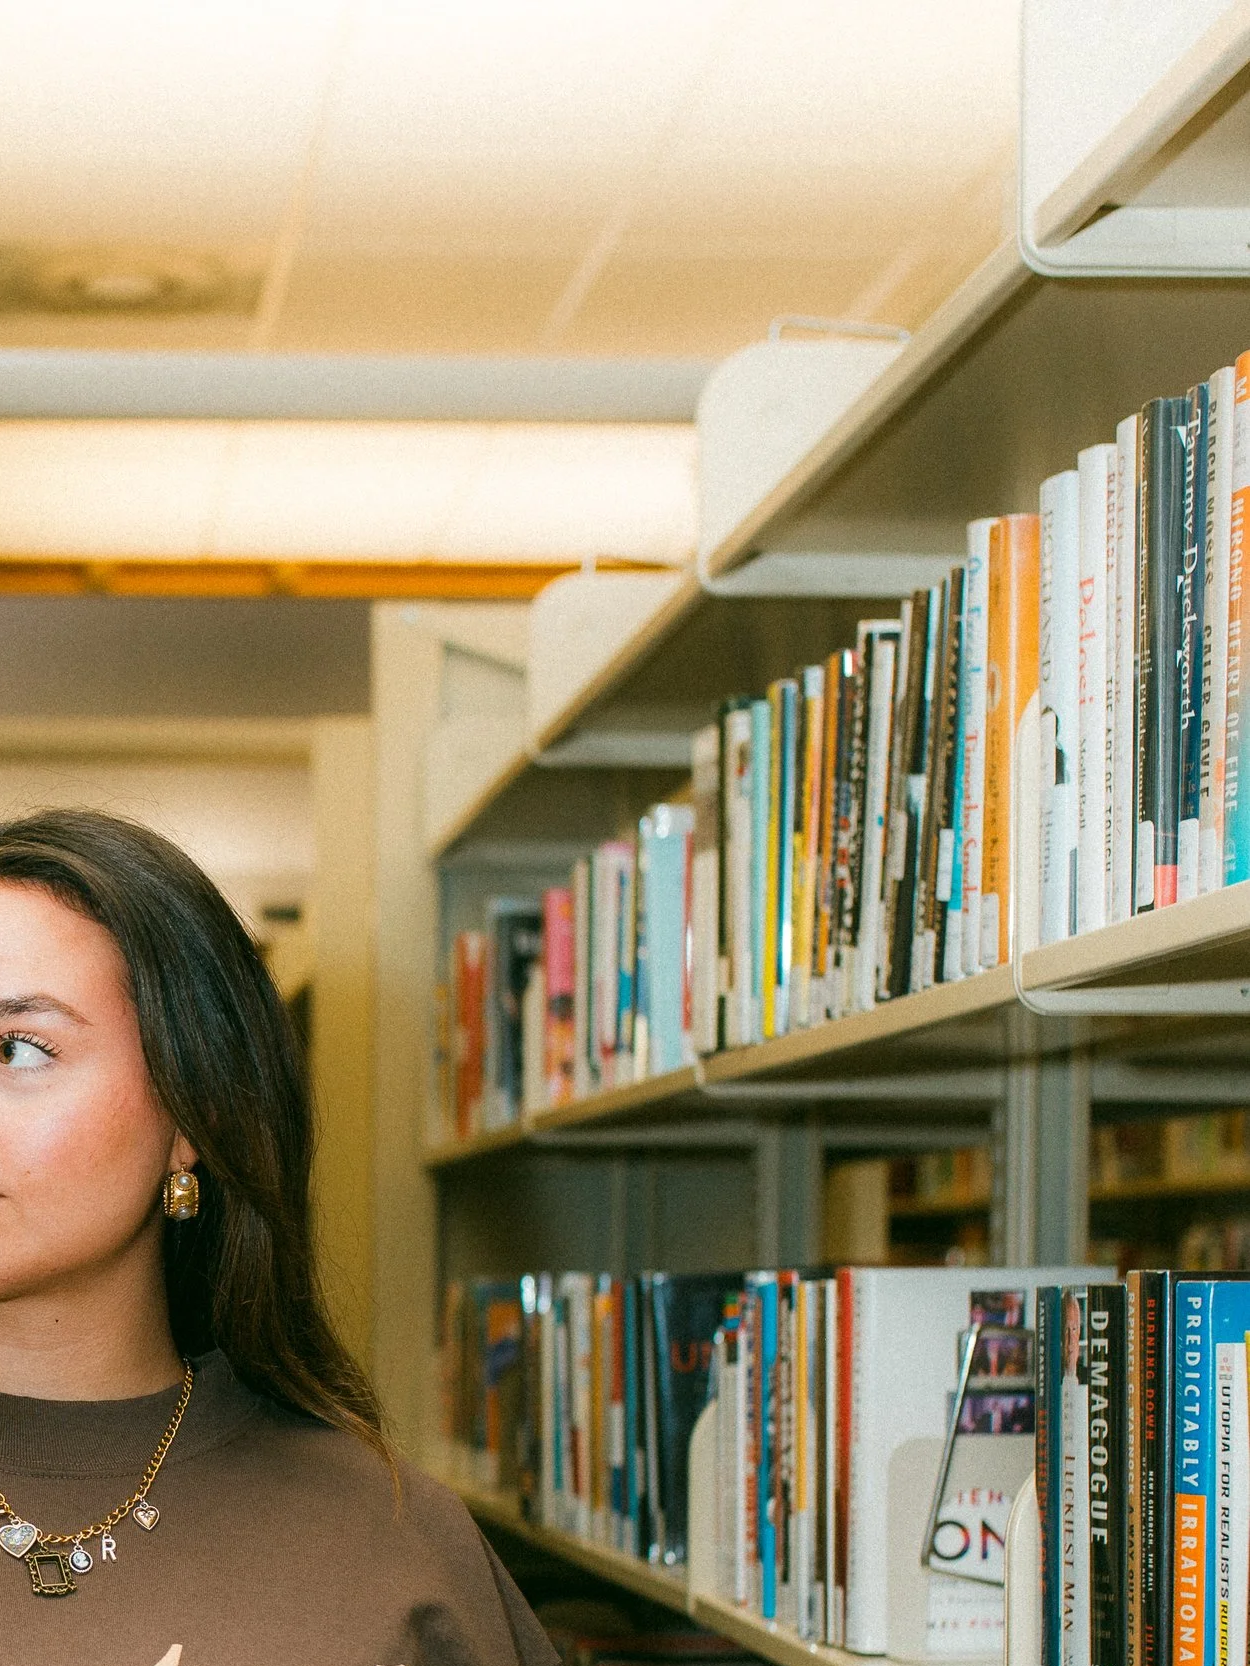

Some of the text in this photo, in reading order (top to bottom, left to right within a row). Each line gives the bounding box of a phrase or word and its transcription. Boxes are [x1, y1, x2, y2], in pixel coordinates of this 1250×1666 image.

[1204, 401, 1217, 588] BLACK MOSES
[1181, 408, 1202, 730] Tammy Duckworth
[1230, 497, 1246, 602] HIRONO
[1200, 625, 1213, 798] CALEB GAYLE
[1224, 619, 1243, 812] HEART OF FIRE
[1144, 1298, 1156, 1441] BURNING DOWN
[1182, 1296, 1203, 1488] PREDICTABLY
[1218, 1386, 1232, 1453] UTOPIA
[1089, 1310, 1111, 1546] DEMAGOGUE
[1219, 1461, 1231, 1499] FOR
[101, 1538, 118, 1563] R
[1063, 1455, 1076, 1572] LUCKIEST
[1127, 1521, 1136, 1562] WAY
[1218, 1505, 1231, 1599] REALISTS
[1062, 1580, 1075, 1633] MAN
[1126, 1613, 1136, 1639] OF
[1127, 1569, 1136, 1604] OUT
